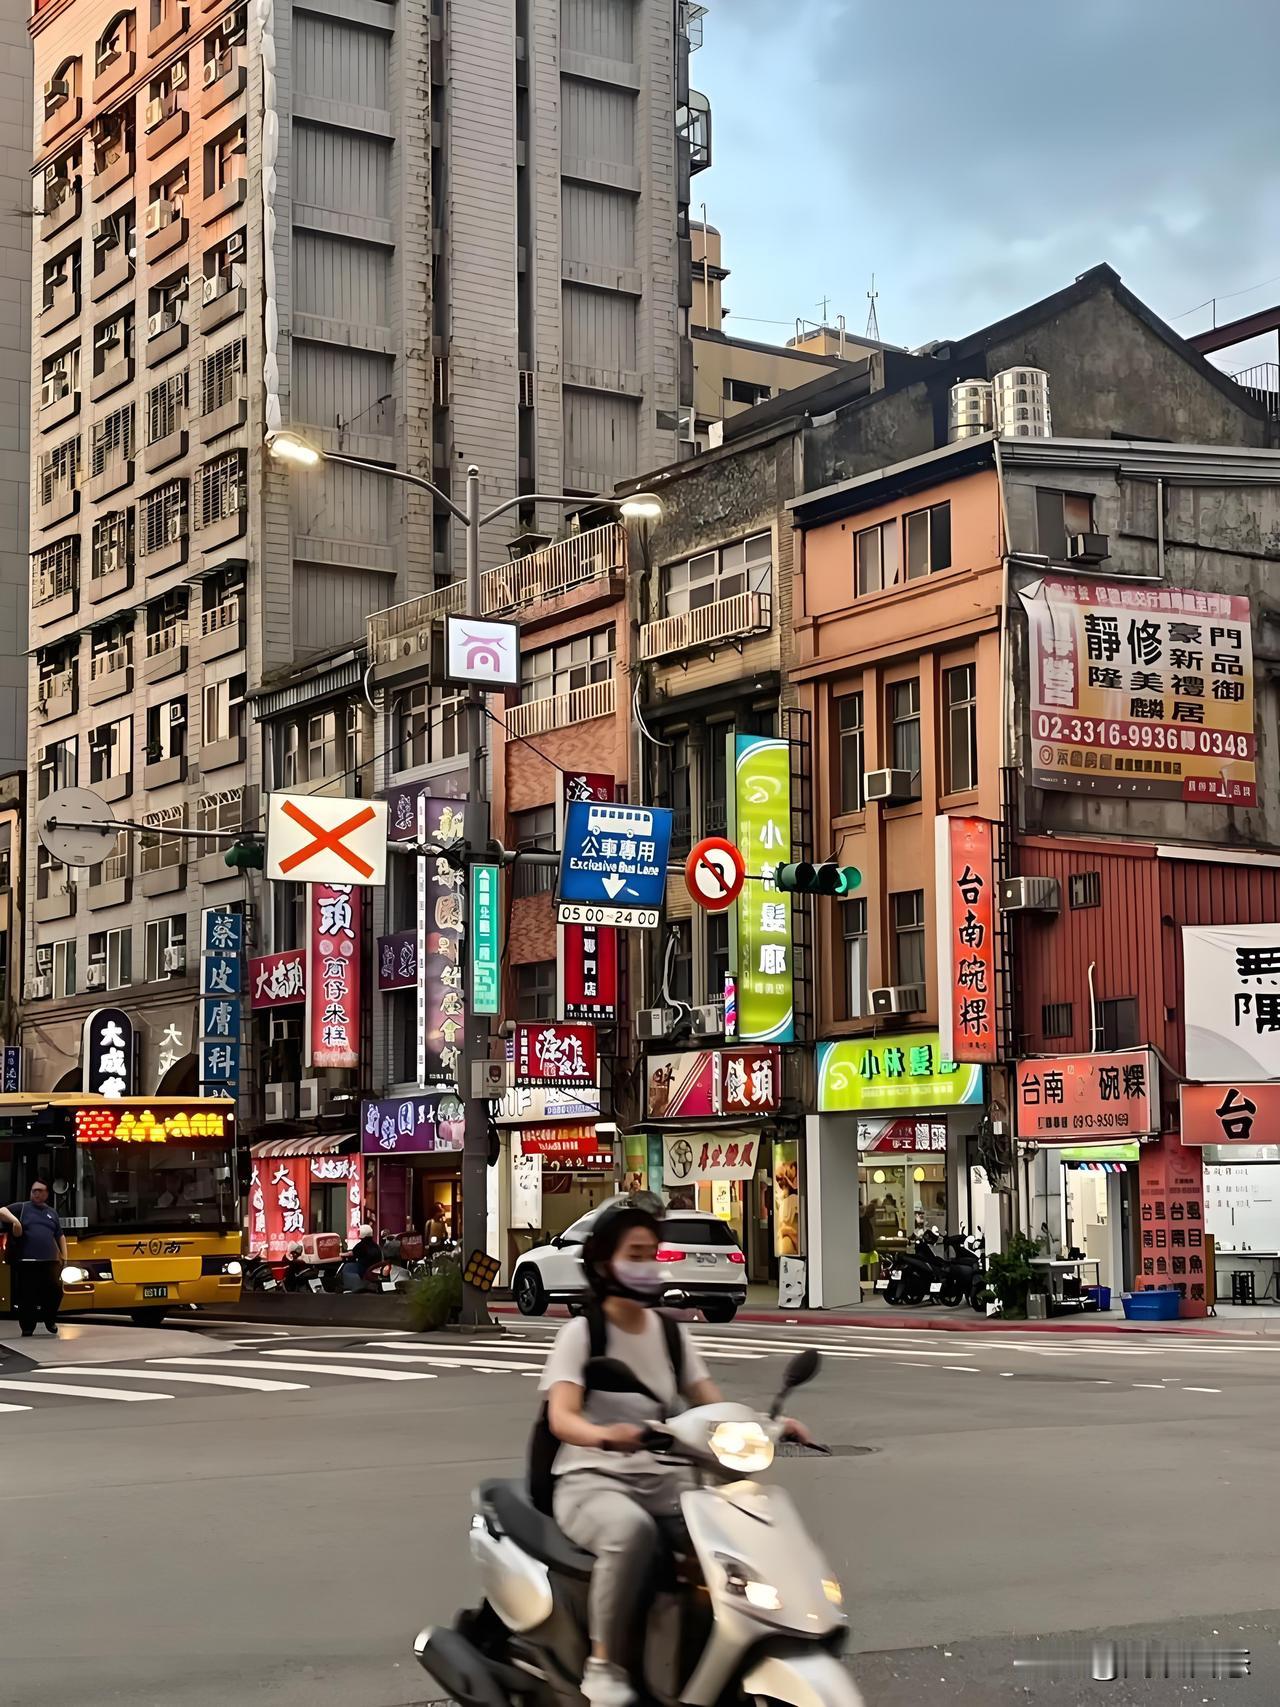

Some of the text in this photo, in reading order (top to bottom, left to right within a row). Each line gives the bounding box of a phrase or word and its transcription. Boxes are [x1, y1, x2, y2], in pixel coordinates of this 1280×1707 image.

[1084, 614, 1163, 666] 靜修
[1169, 648, 1243, 677] 新品
[570, 858, 618, 872] Exclusive
[618, 861, 636, 875] Bus
[581, 836, 656, 863] 公車專用
[562, 907, 581, 921] 05
[585, 908, 604, 923] 00
[638, 912, 656, 926] 00
[957, 864, 989, 1036] 台南碗粿
[207, 915, 239, 1097] 蔡皮膚科
[1021, 1070, 1064, 1105] 台南
[1216, 1088, 1257, 1139] 台
